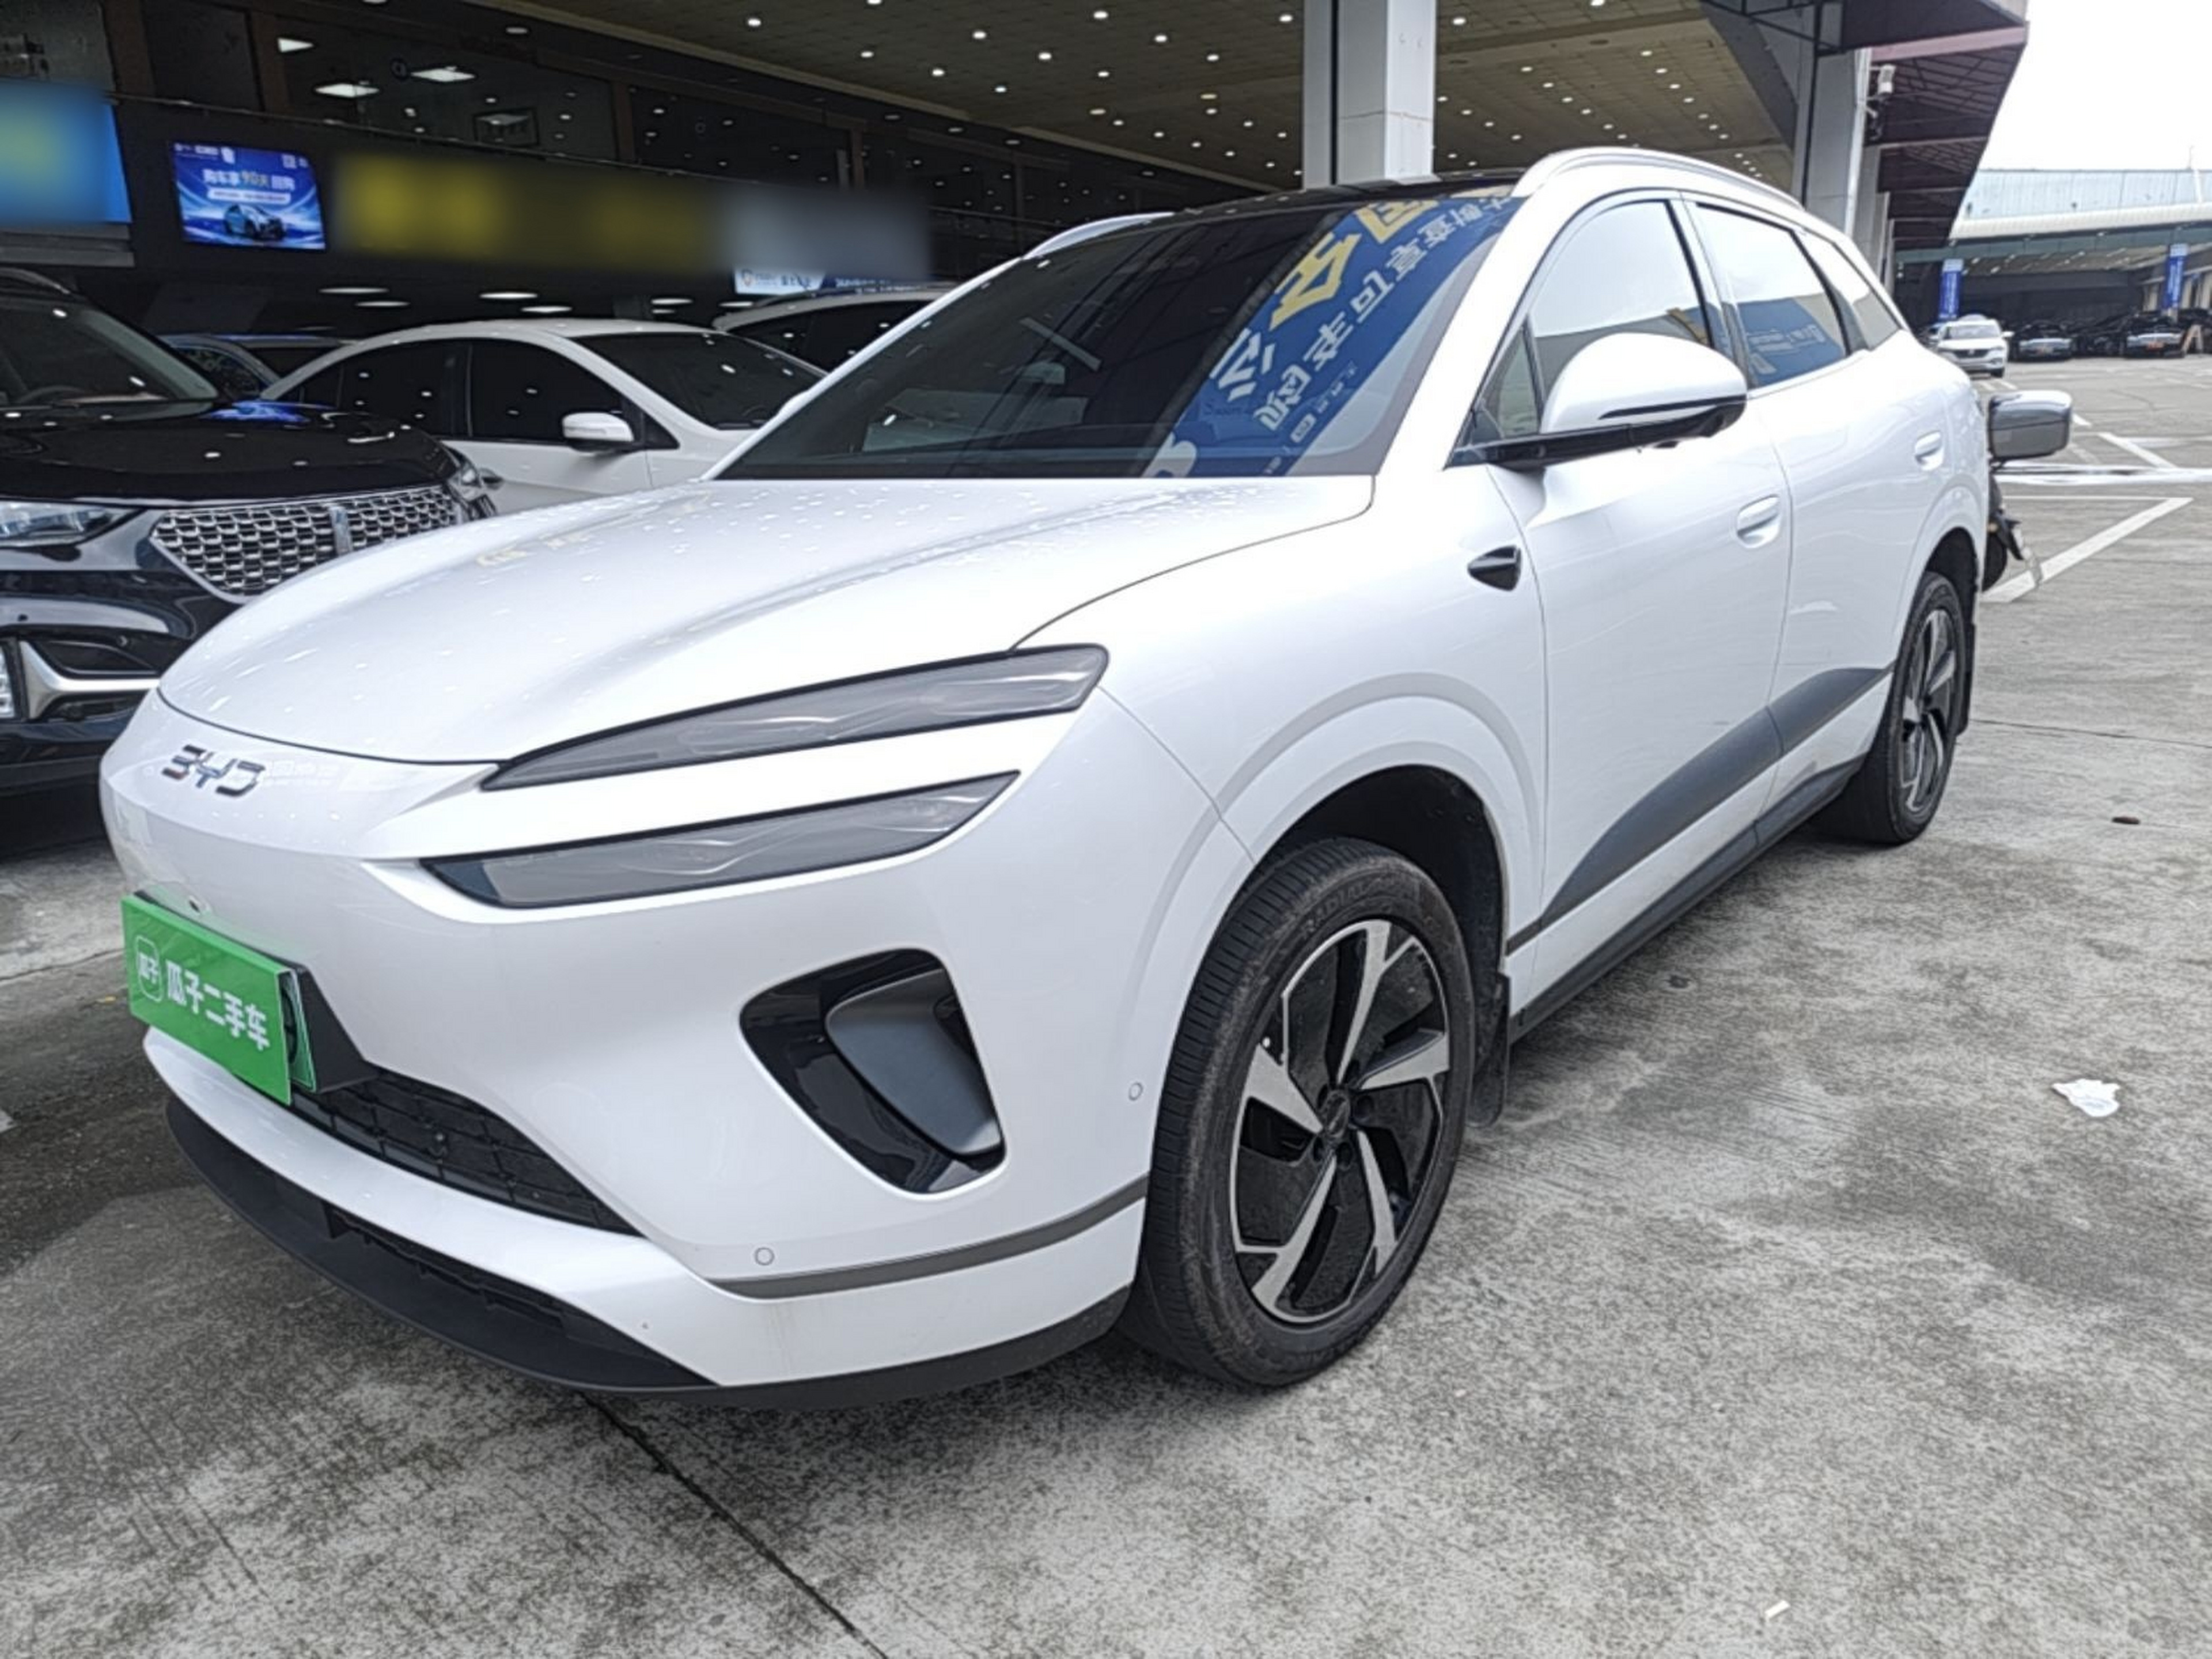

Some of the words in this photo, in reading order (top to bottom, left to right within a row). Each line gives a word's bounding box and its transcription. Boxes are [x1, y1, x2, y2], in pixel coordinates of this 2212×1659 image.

[162, 744, 265, 797] BYD
[165, 959, 271, 1052] 瓜子二手车
